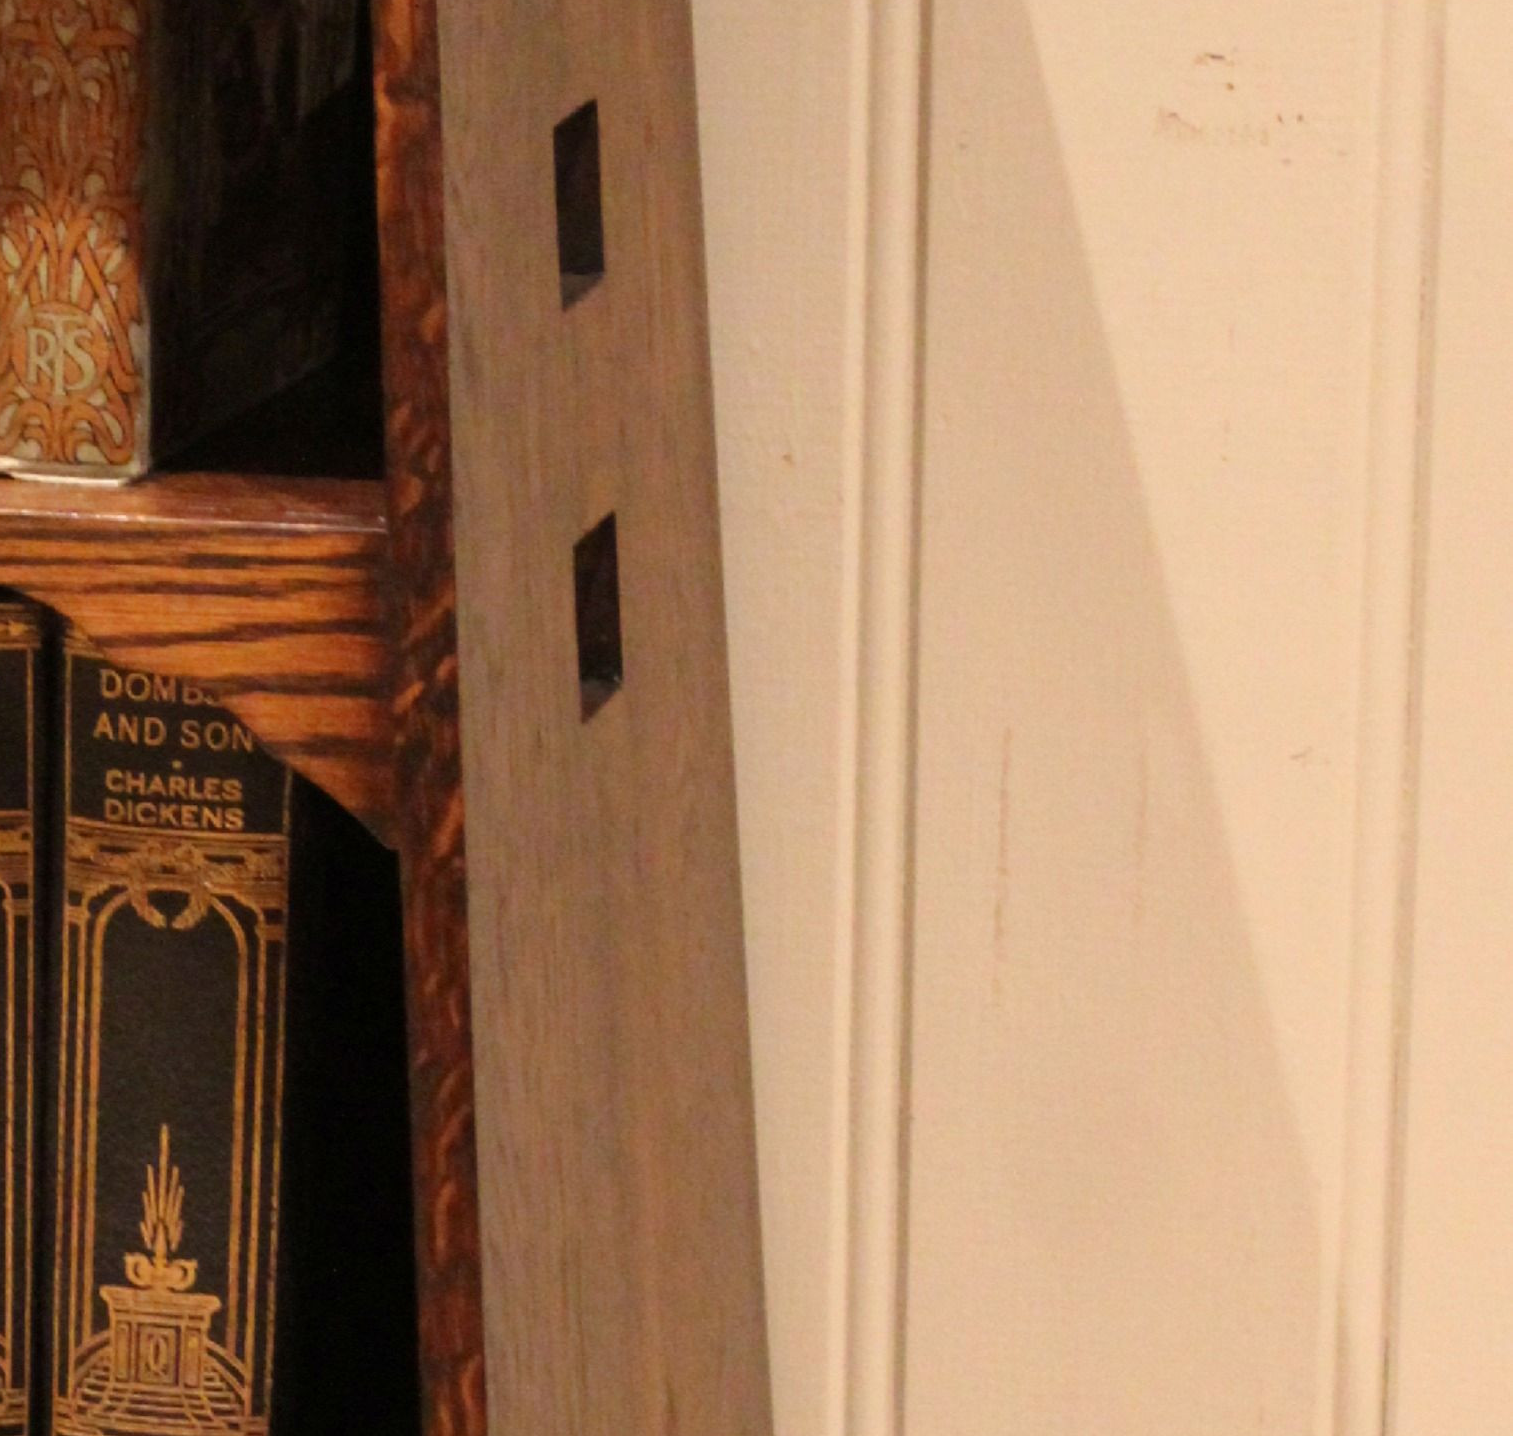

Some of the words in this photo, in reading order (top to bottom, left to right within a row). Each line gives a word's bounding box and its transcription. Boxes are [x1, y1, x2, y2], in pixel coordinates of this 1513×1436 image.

[92, 711, 168, 748] AND
[179, 719, 256, 754] SON
[105, 768, 244, 803] CHARLES
[103, 797, 246, 833] DICKENS
